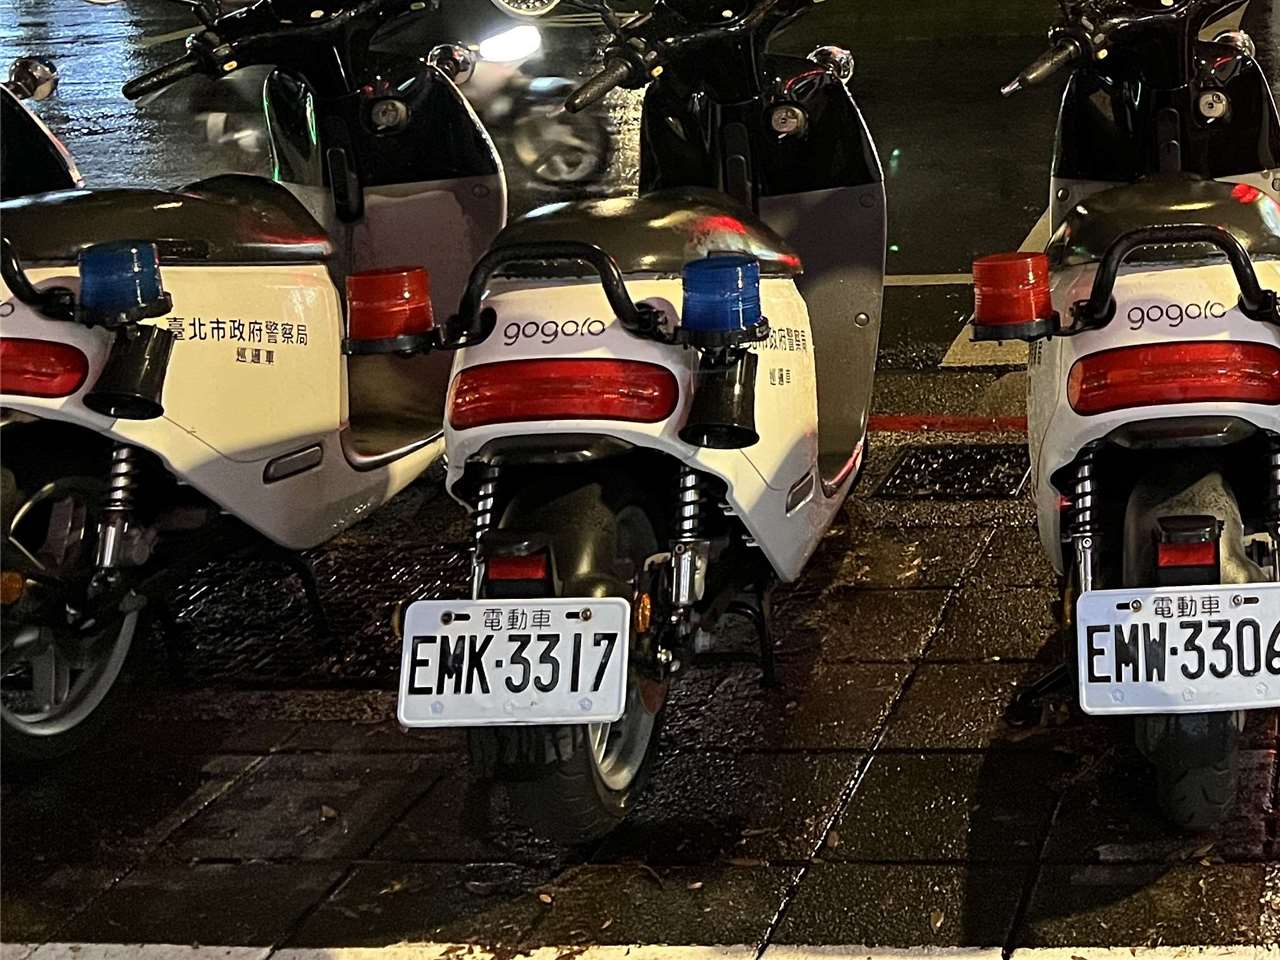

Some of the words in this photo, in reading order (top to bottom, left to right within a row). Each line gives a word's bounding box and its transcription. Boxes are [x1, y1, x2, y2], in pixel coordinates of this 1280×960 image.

[1127, 300, 1227, 330] gogoro
[166, 317, 308, 346] 臺北市政府警察局
[504, 317, 605, 346] gogoro
[483, 608, 551, 631] 電動車
[1153, 596, 1221, 618] 電動車
